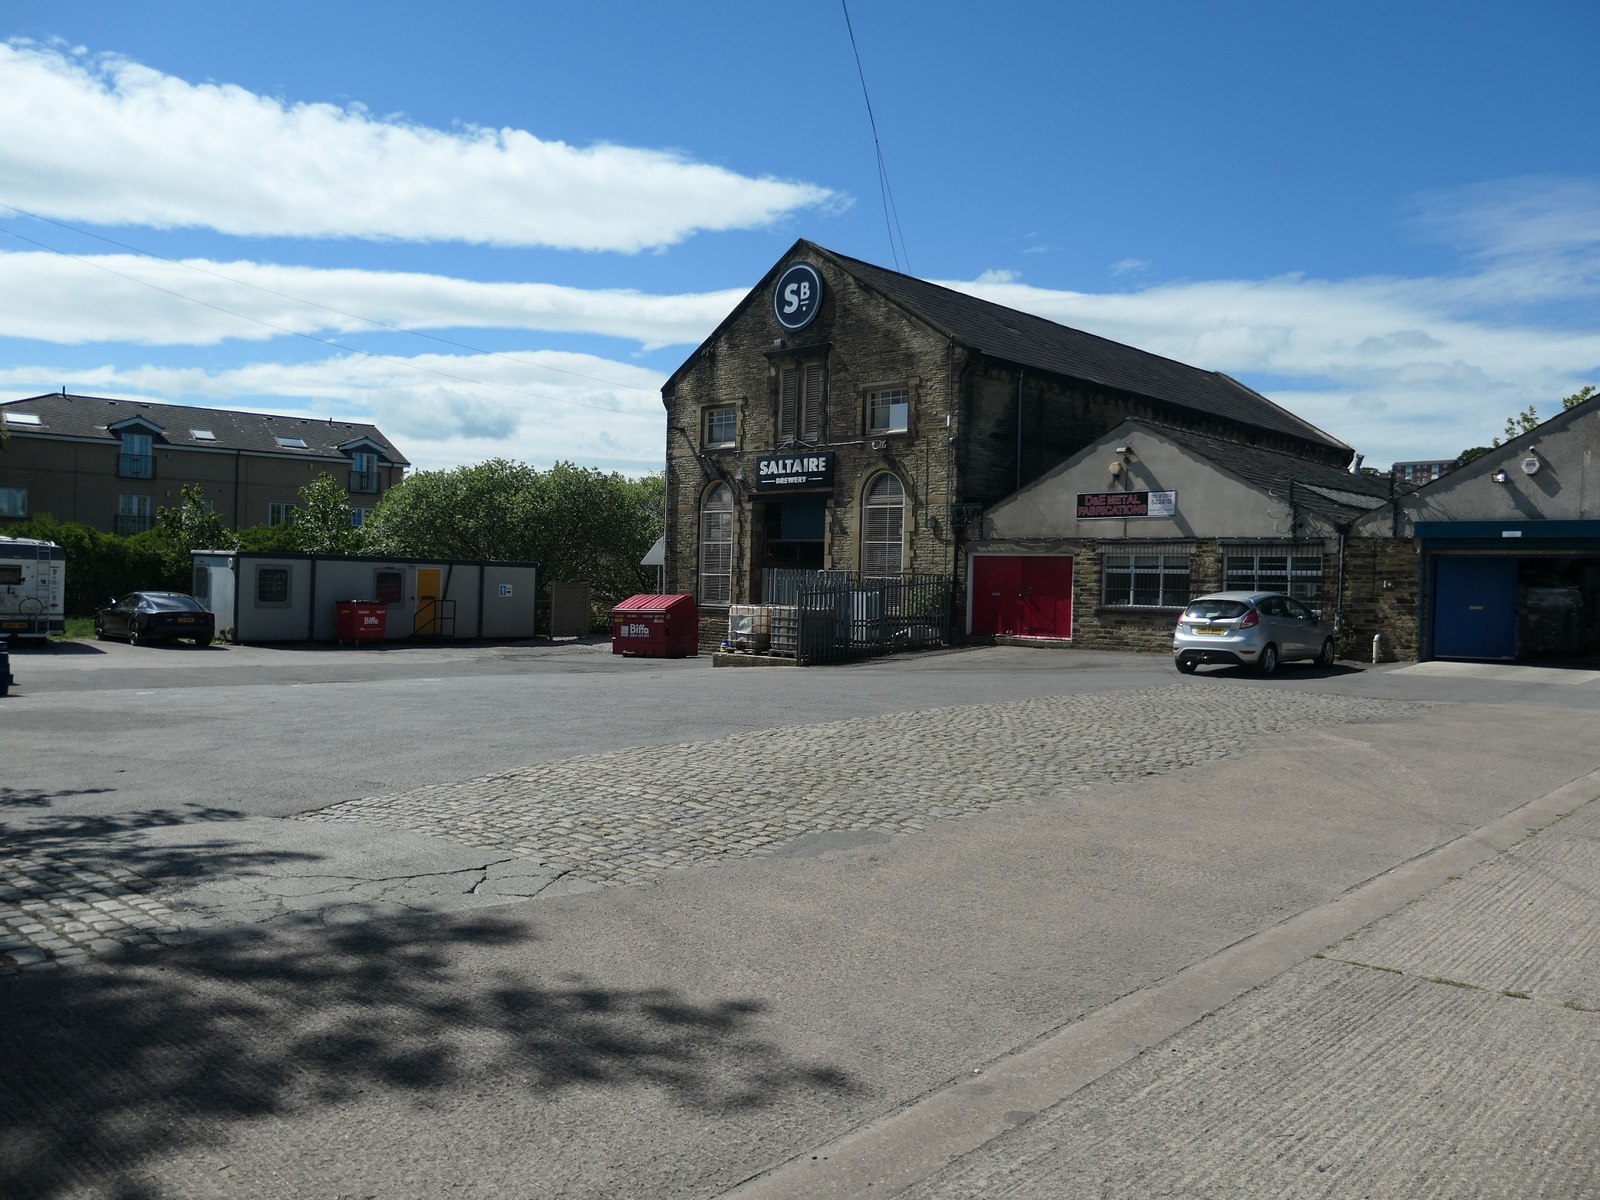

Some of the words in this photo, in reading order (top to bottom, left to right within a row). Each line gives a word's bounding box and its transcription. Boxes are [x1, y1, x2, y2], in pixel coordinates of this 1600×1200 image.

[759, 456, 827, 475] SALTAIRE
[775, 476, 808, 485] BREWERY
[1107, 495, 1140, 504] METAL
[1078, 505, 1147, 516] FABRICATIONS
[630, 624, 649, 633] Biffa
